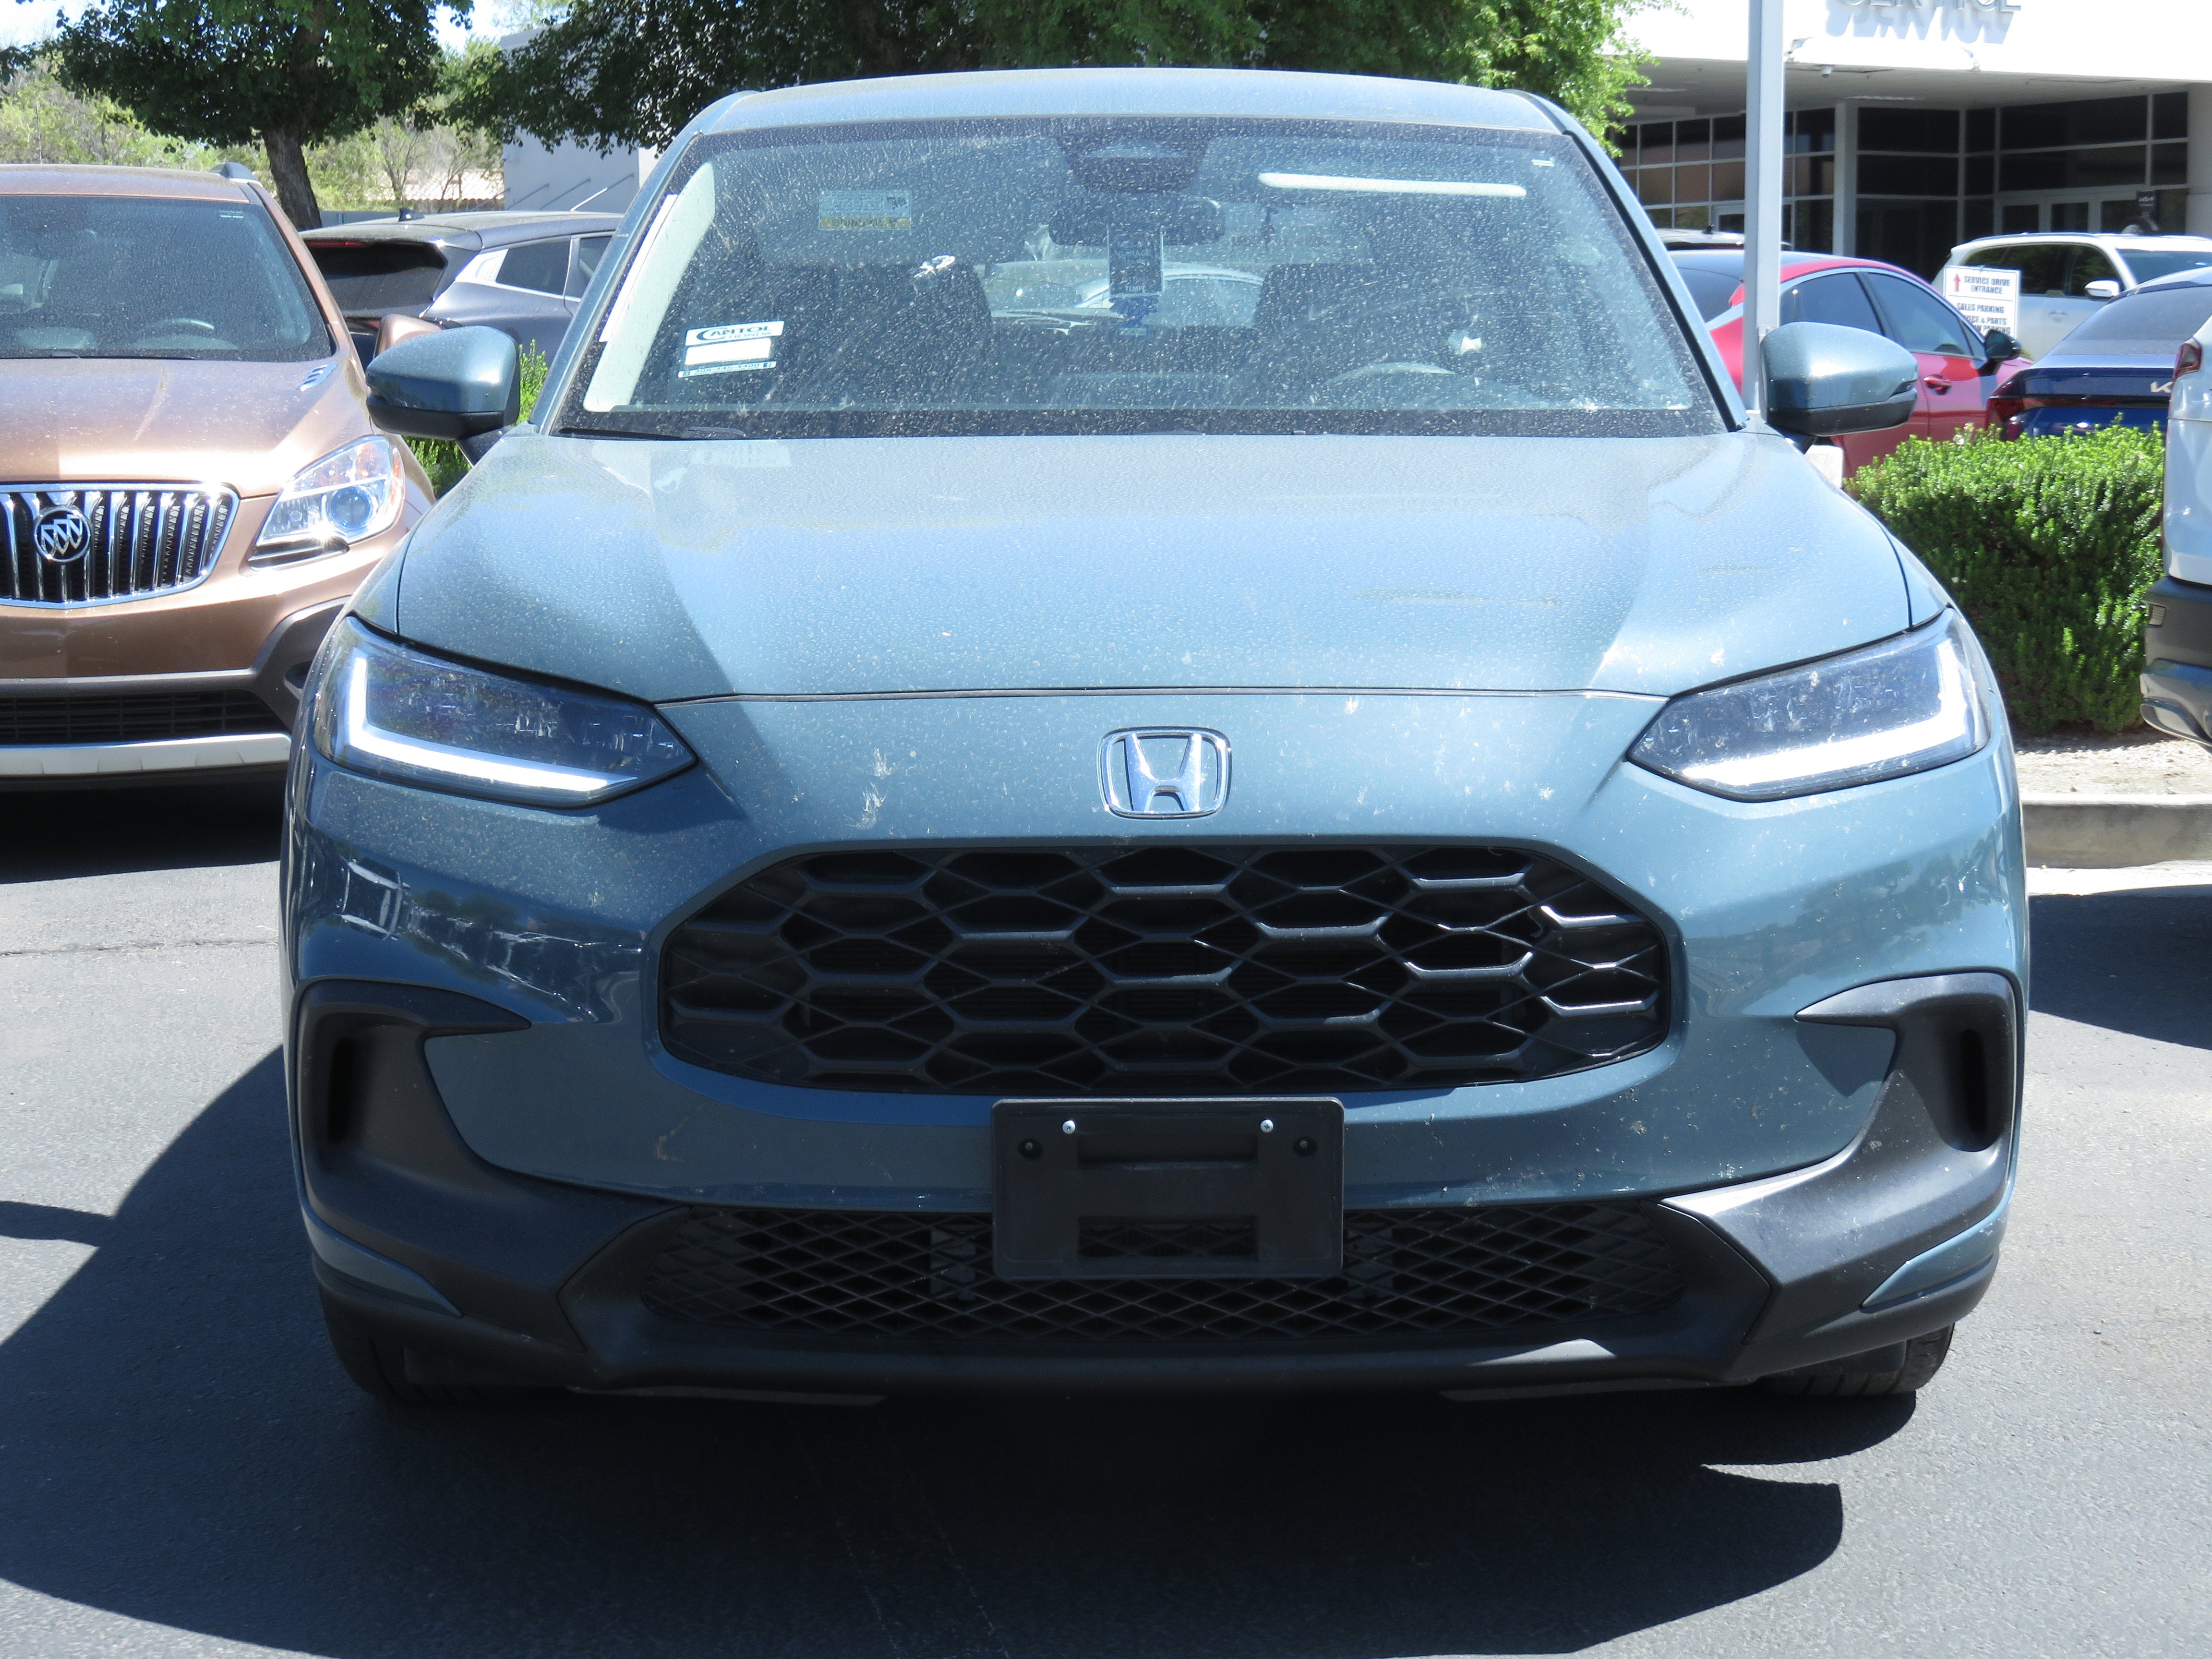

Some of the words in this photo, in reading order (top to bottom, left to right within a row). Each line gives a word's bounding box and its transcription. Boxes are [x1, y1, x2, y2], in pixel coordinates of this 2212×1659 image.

[1964, 276, 1990, 285] SERVICE
[1971, 285, 2003, 294] ENTRANCE
[1957, 302, 1976, 312] SALES
[1977, 305, 2004, 314] PARKING
[1986, 317, 2007, 325] PARTS
[697, 326, 771, 341] CAPITOL
